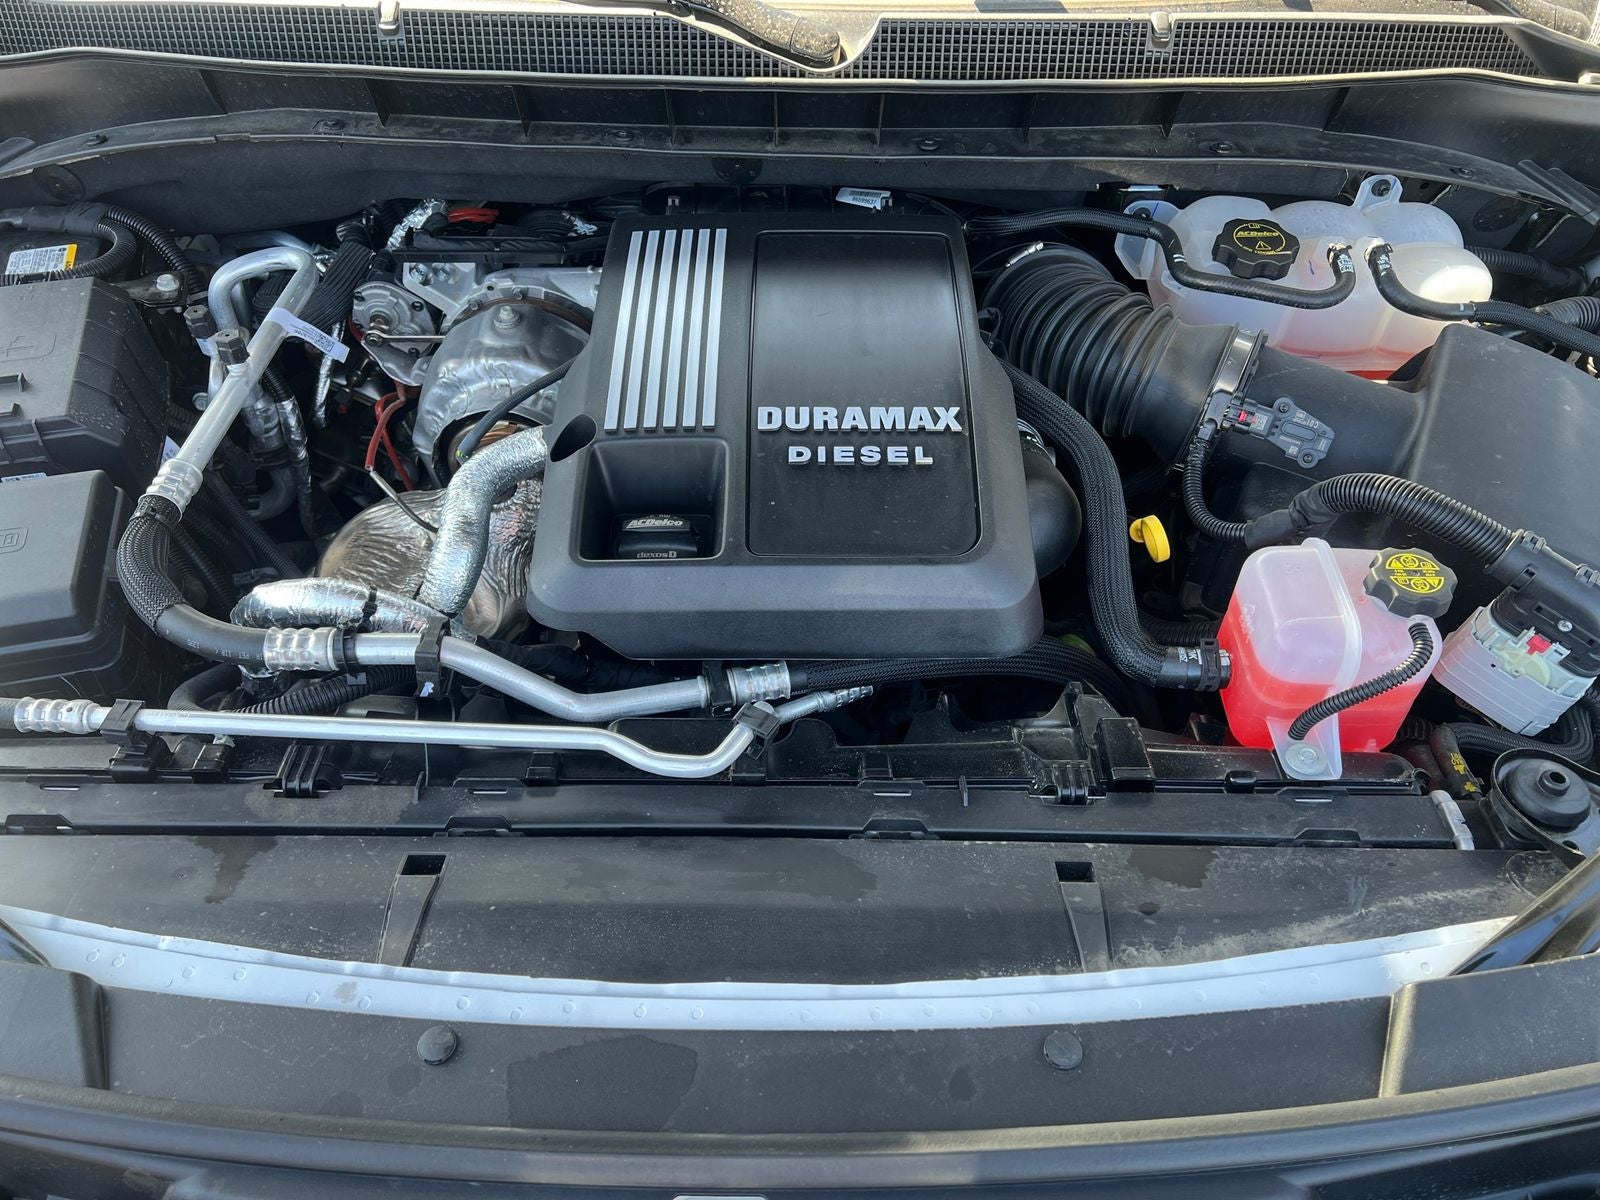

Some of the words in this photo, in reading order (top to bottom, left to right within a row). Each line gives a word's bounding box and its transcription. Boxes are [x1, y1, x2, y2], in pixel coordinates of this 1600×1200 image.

[757, 406, 963, 432] DURAMAX
[788, 445, 934, 465] DIESEL
[626, 518, 683, 529] ACDelco
